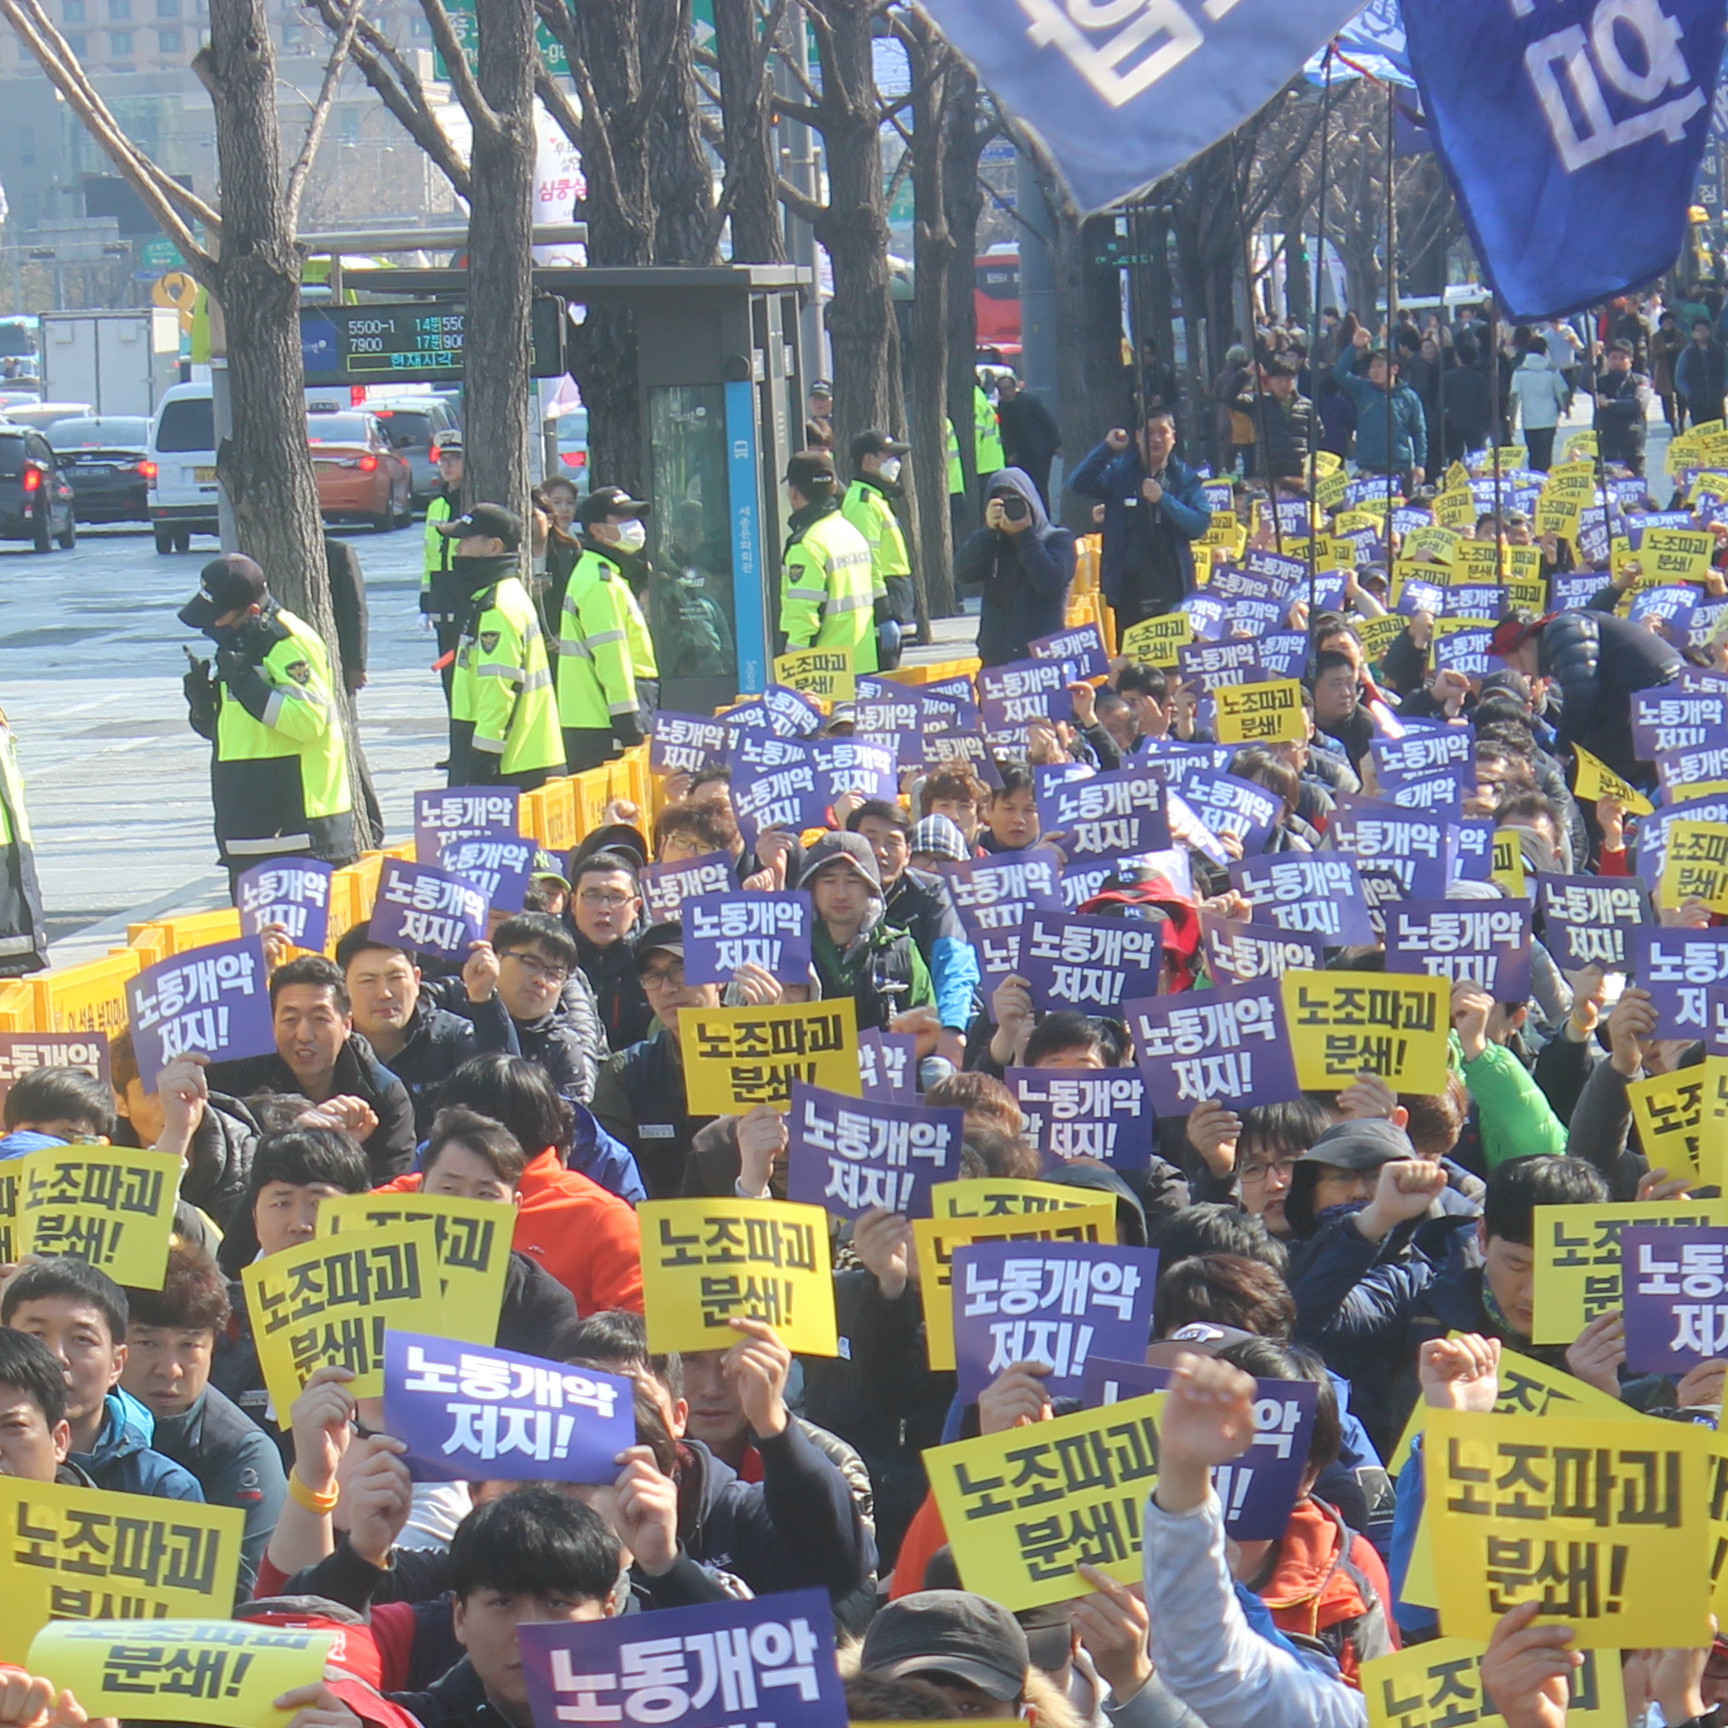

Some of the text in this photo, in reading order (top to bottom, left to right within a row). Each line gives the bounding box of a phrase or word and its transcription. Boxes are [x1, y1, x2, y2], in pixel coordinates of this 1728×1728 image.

[348, 319, 395, 335] 5500-1
[415, 316, 440, 333] 14분
[350, 337, 383, 352] 7900
[416, 334, 440, 350] 17분
[391, 352, 453, 369] 현재시각
[1649, 534, 1708, 553] 노조파괴
[1656, 554, 1694, 572] 분쇄!
[1202, 666, 1245, 687] 저지!
[1223, 685, 1297, 715] 노조파괴
[1004, 695, 1049, 719] 저지!
[1241, 713, 1283, 736] 분쇄!
[1638, 698, 1724, 728] 노동개악
[661, 746, 705, 772] 저지!
[814, 740, 892, 772] 노동개악
[1654, 724, 1708, 749] 저지!
[827, 766, 878, 794] 저지!
[1057, 775, 1158, 823] 노동개악
[421, 796, 515, 829] 노동개악
[752, 792, 803, 825] 저지!
[384, 869, 488, 925] 노동개악
[1240, 861, 1354, 905] 노동개악
[692, 899, 804, 938] 노동개악
[1397, 909, 1524, 952] 노동개악
[1030, 921, 1156, 970] 노동개악
[133, 952, 258, 1031] 노동개악
[1297, 984, 1437, 1033] 노조파괴
[698, 1012, 844, 1060] 노조파괴
[1138, 995, 1276, 1056] 노동개악
[1172, 1049, 1252, 1101] 저지!
[803, 1099, 952, 1164] 노동개악
[25, 1160, 165, 1220] 노조파괴
[658, 1215, 817, 1274] 노조파괴
[255, 1241, 423, 1337] 노조파괴
[964, 1255, 1143, 1320] 노동개악
[403, 1345, 619, 1419] 노동개악
[440, 1402, 575, 1461] 저지!
[953, 1417, 1160, 1523] 노조파괴
[1444, 1434, 1684, 1530] 노조파괴
[14, 1499, 223, 1598] 노조파괴
[1485, 1534, 1631, 1618] 분쇄!
[101, 1641, 253, 1700] 분쇄!
[551, 1616, 822, 1726] 노동개악
